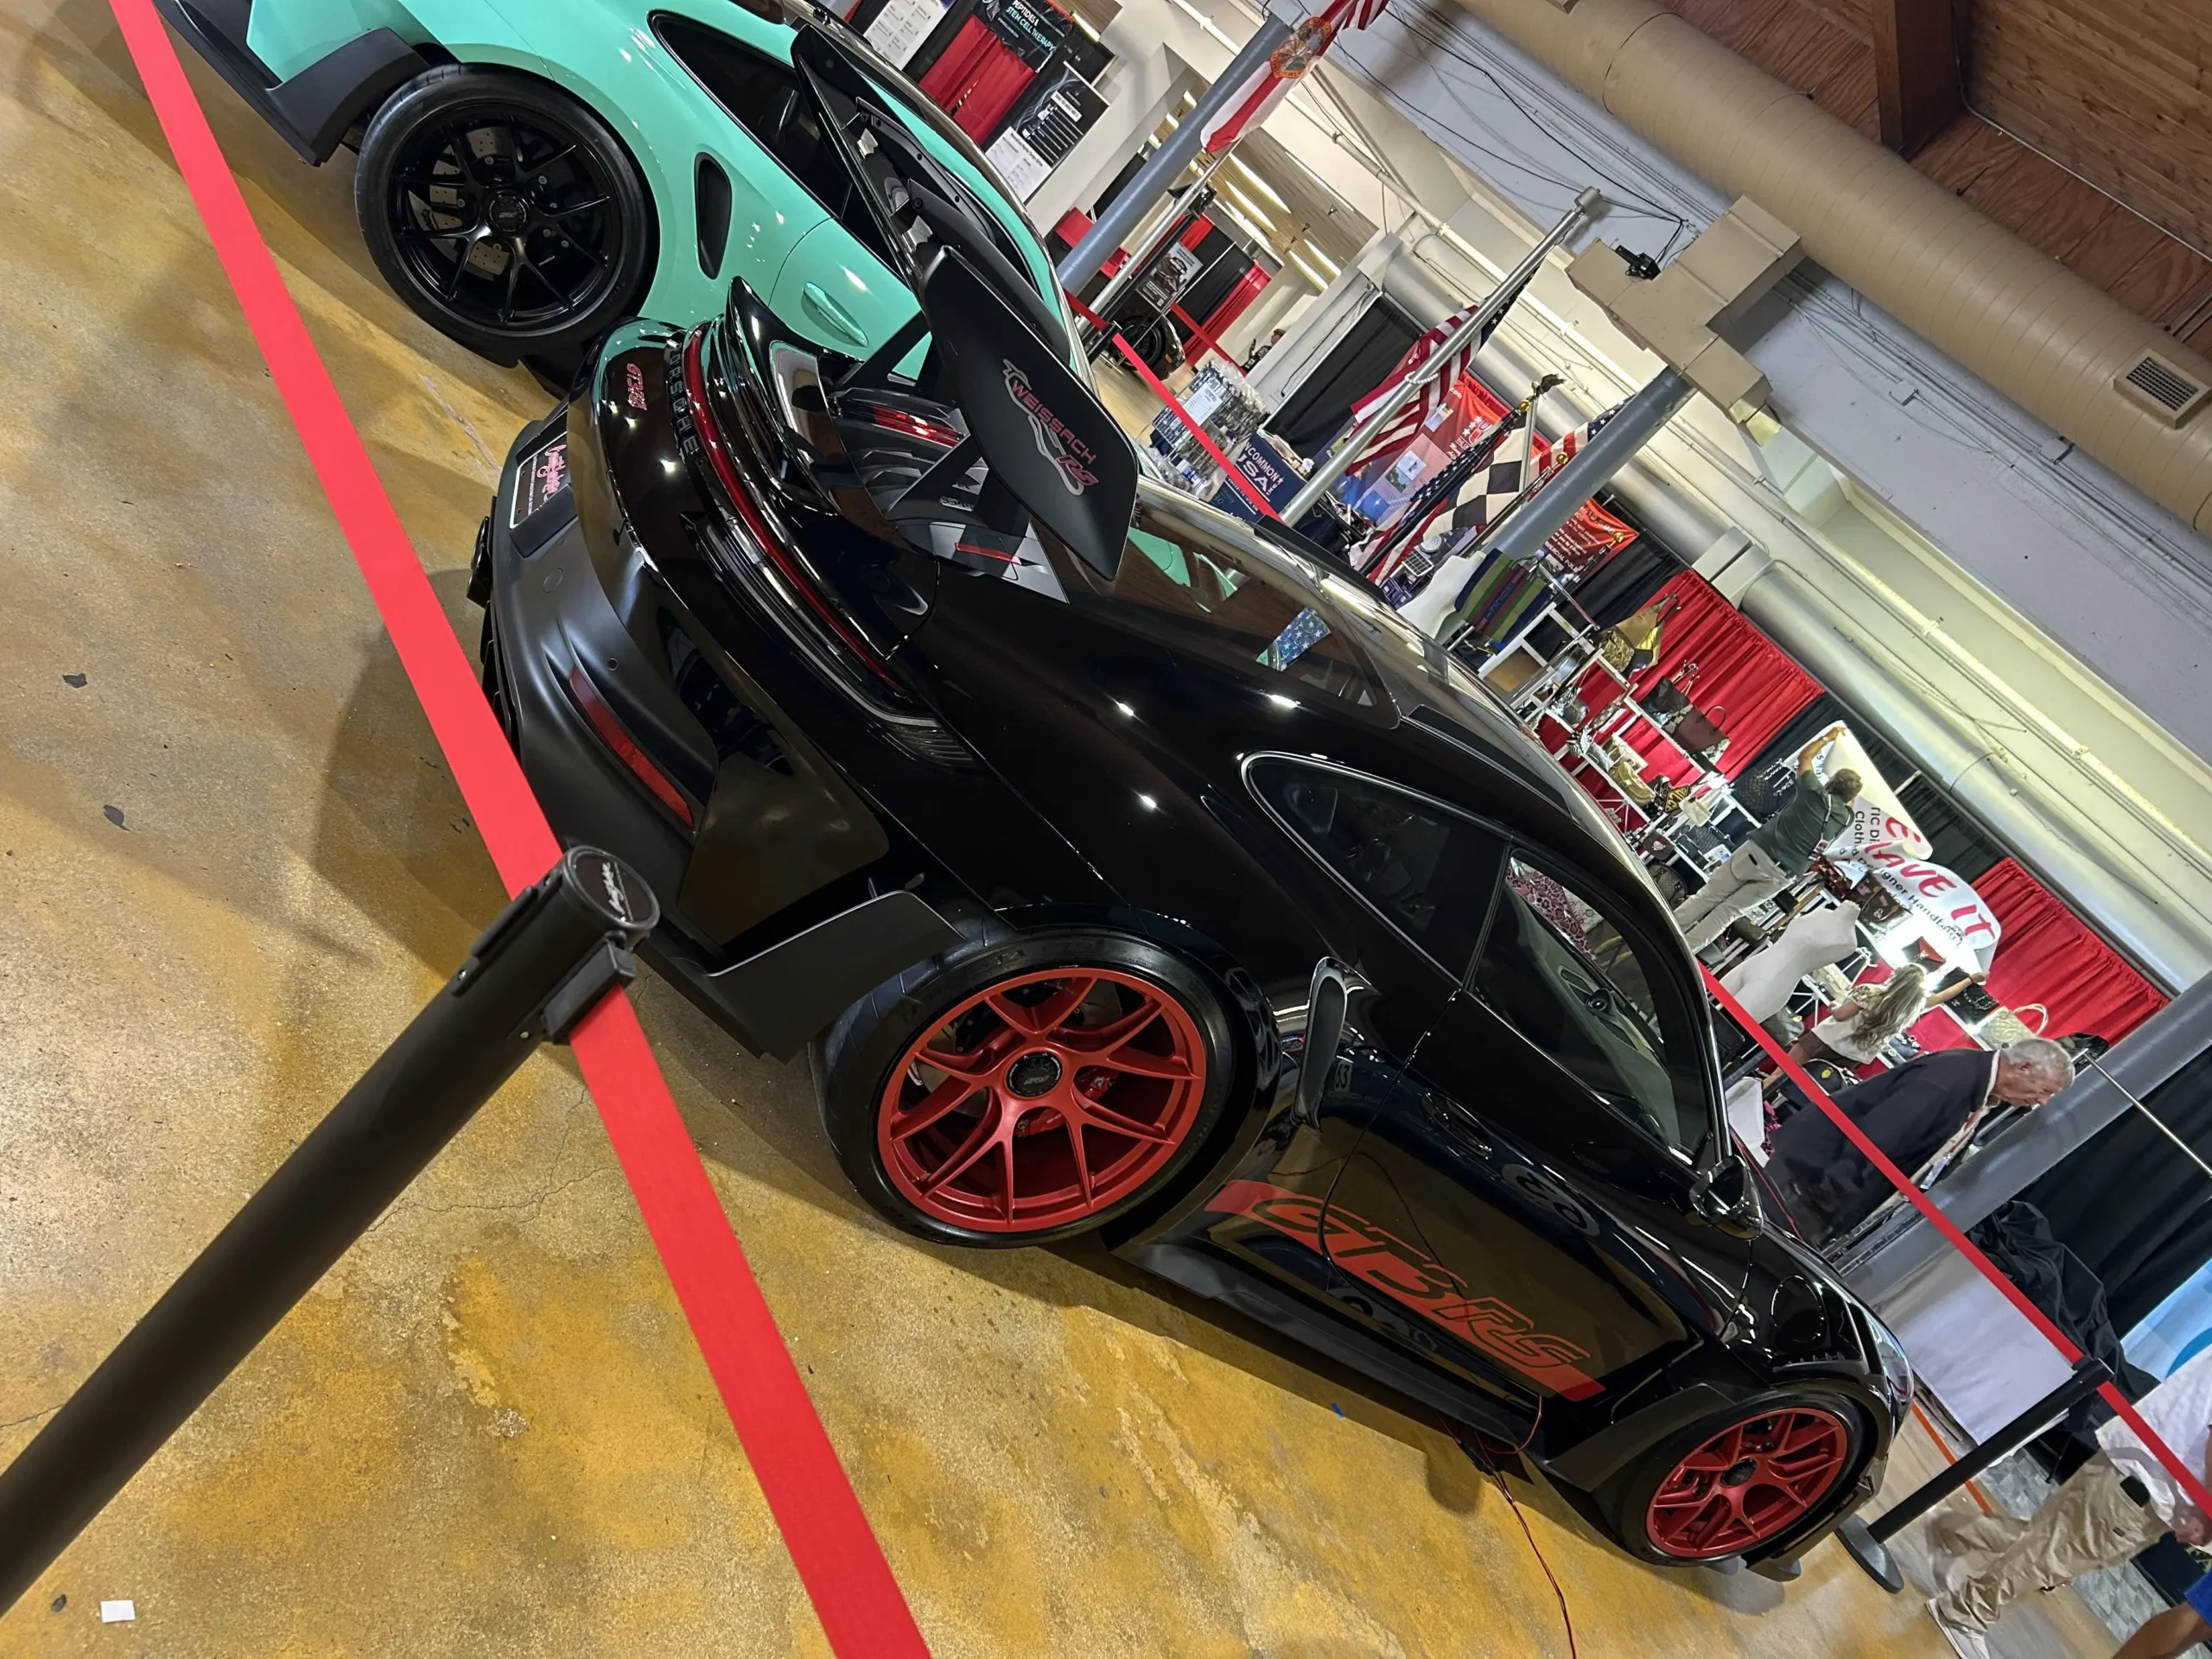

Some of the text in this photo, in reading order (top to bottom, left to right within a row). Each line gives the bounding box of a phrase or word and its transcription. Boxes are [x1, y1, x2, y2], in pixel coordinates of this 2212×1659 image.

[1006, 6, 1020, 23] STEM
[1020, 17, 1033, 33] CELL
[1012, 0, 1035, 25] PEPTIDES
[1012, 380, 1096, 464] WEISSACH
[1056, 454, 1099, 486] RS
[1244, 442, 1280, 482] NCOMMON
[1950, 904, 1996, 940] IT
